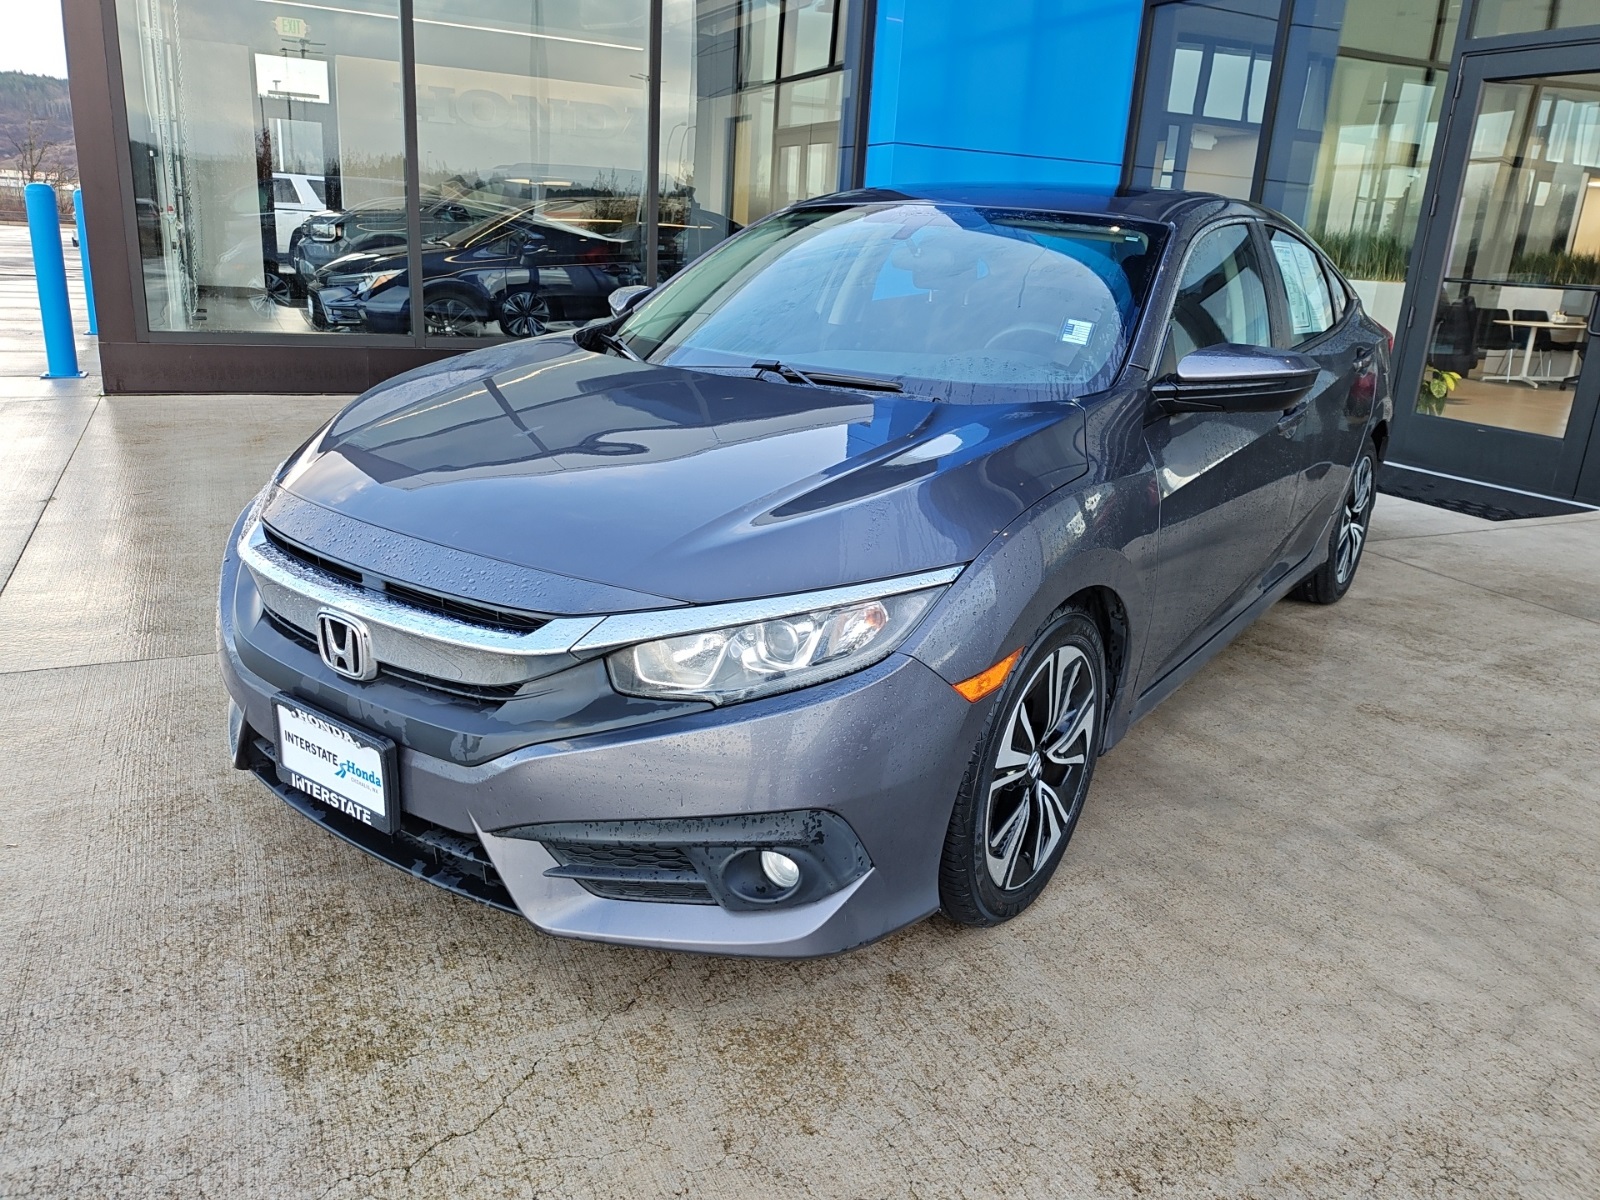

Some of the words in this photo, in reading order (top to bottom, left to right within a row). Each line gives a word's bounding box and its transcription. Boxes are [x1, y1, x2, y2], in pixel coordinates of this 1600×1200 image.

[282, 18, 301, 34] EXIT
[284, 729, 339, 766] INTERSTATE
[346, 759, 382, 788] Honda
[291, 772, 372, 826] INTERSTATE
